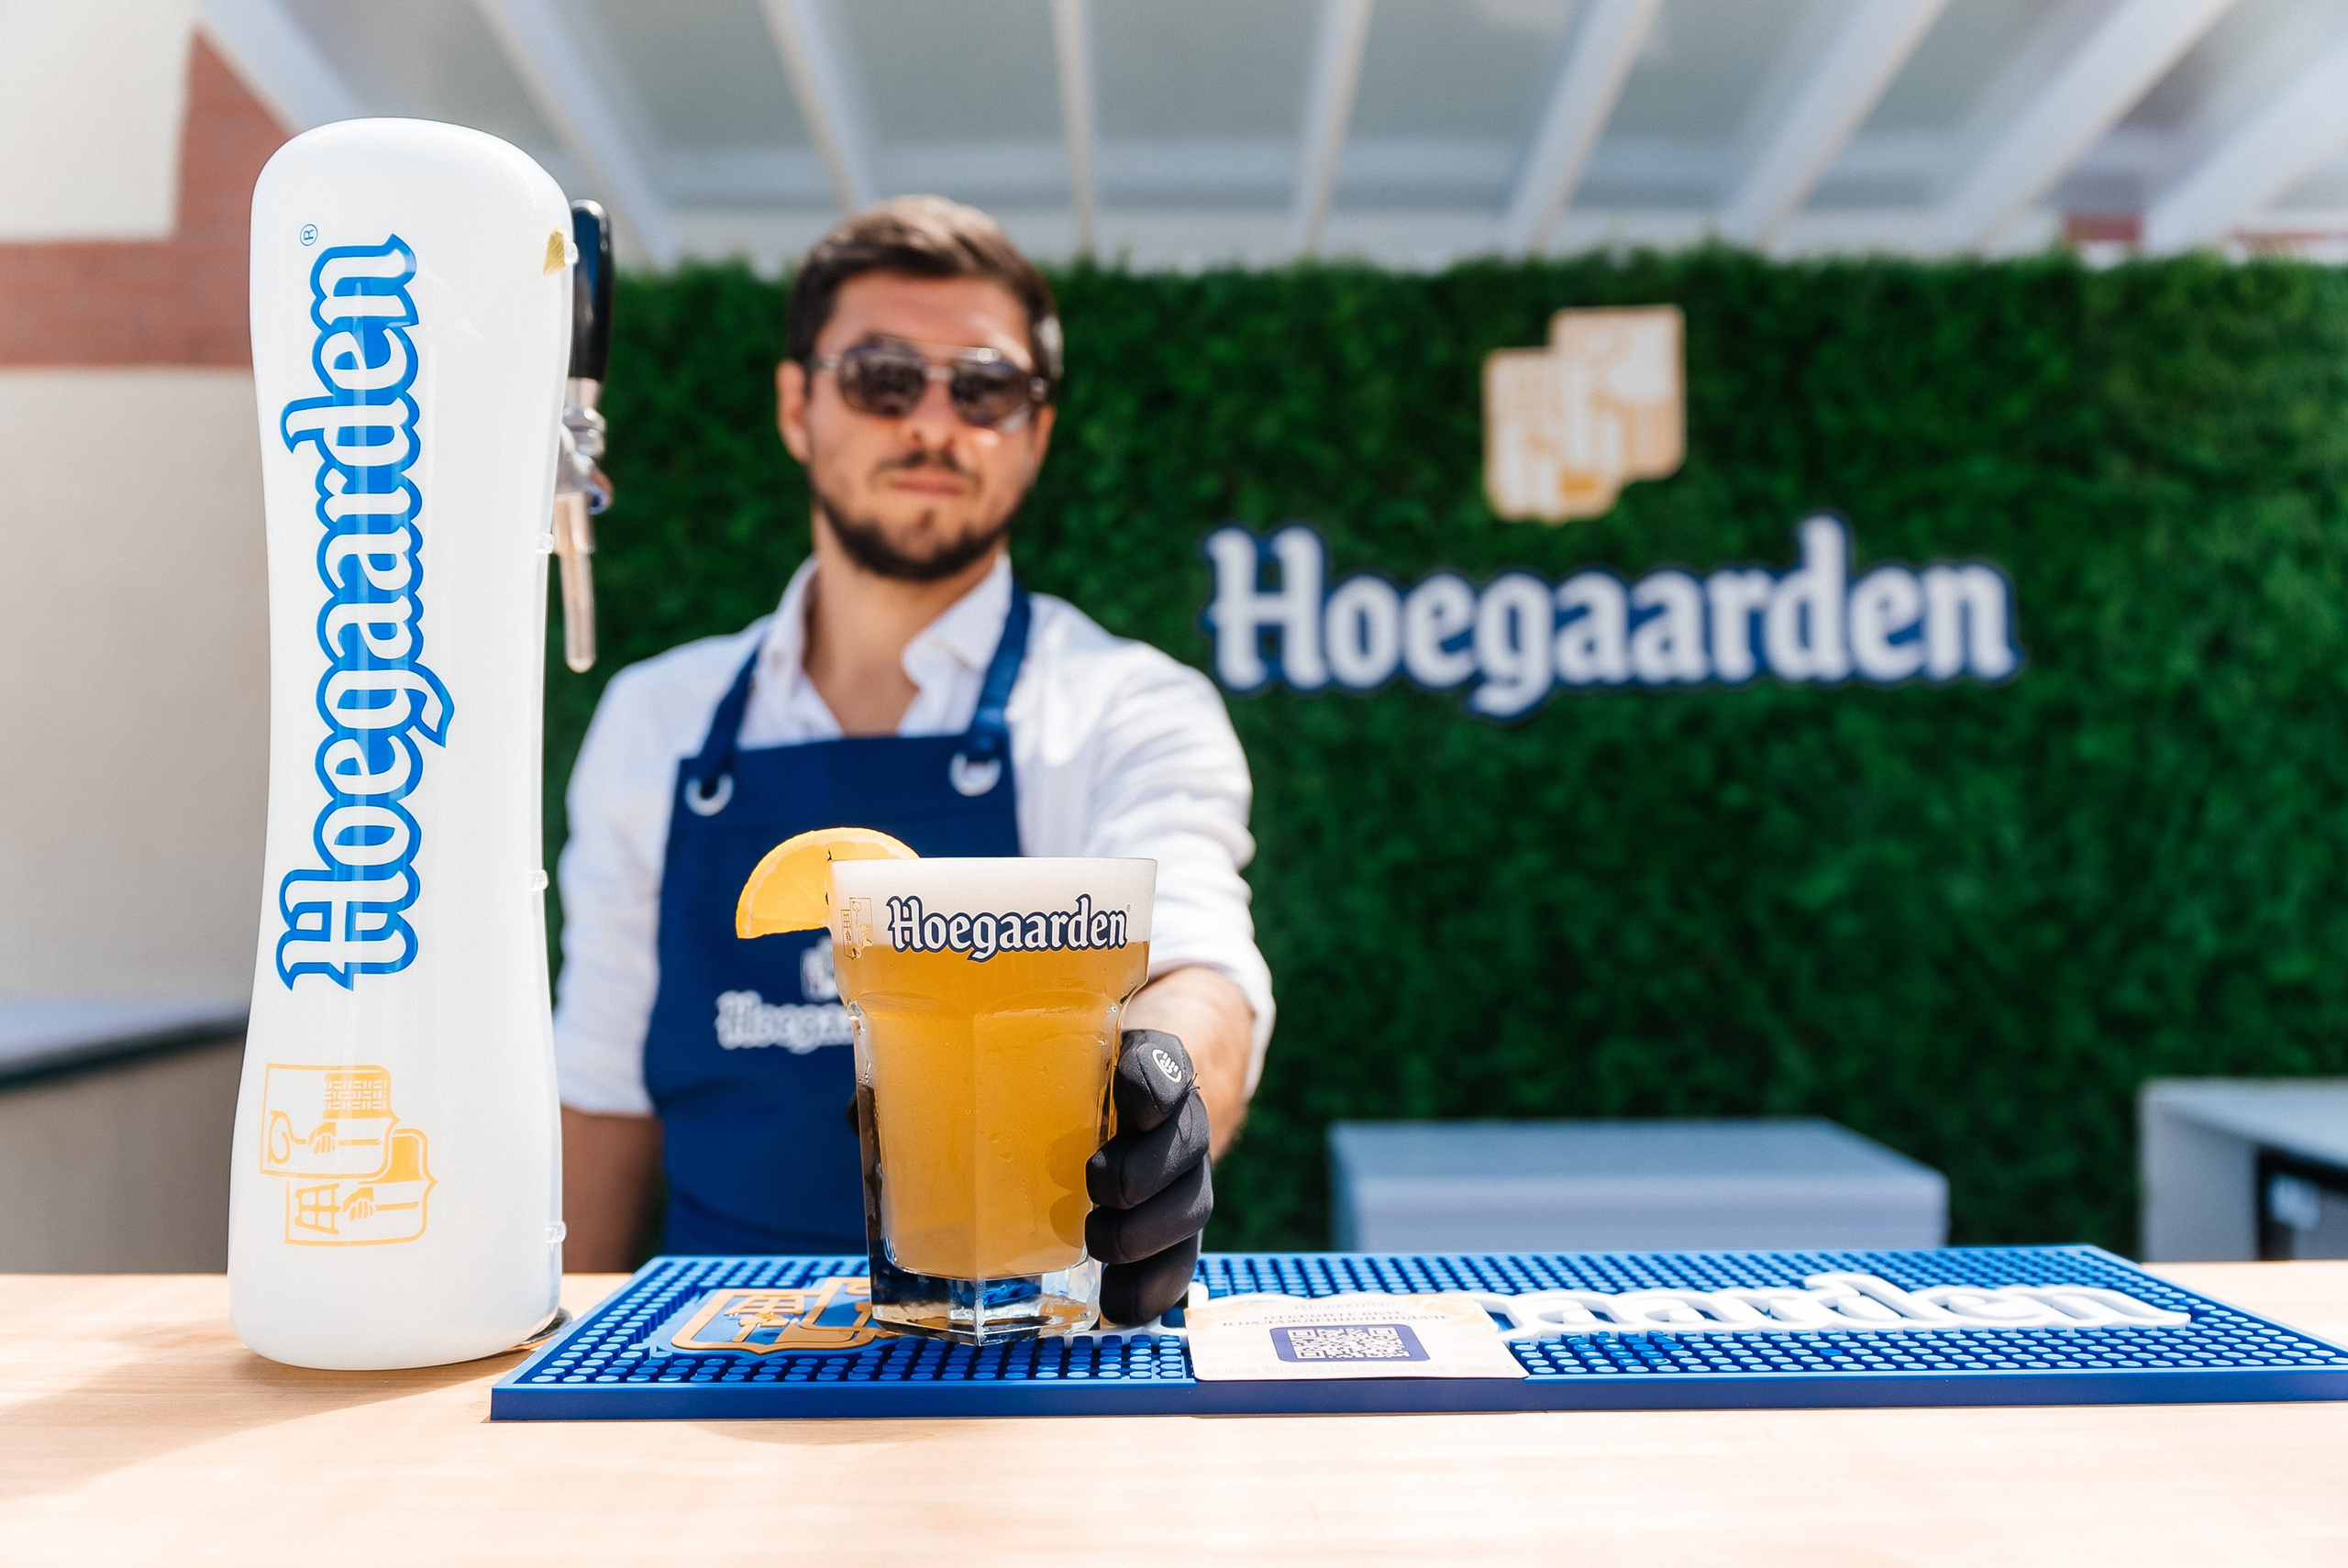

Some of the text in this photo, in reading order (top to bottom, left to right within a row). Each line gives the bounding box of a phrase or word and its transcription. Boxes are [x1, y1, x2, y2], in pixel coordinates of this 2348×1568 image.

[275, 233, 455, 991] Hoegaarden
[1198, 512, 2023, 721] Hoegaarden
[885, 892, 1128, 963] Hoegaarden
[1479, 1273, 2192, 1336] aarden
